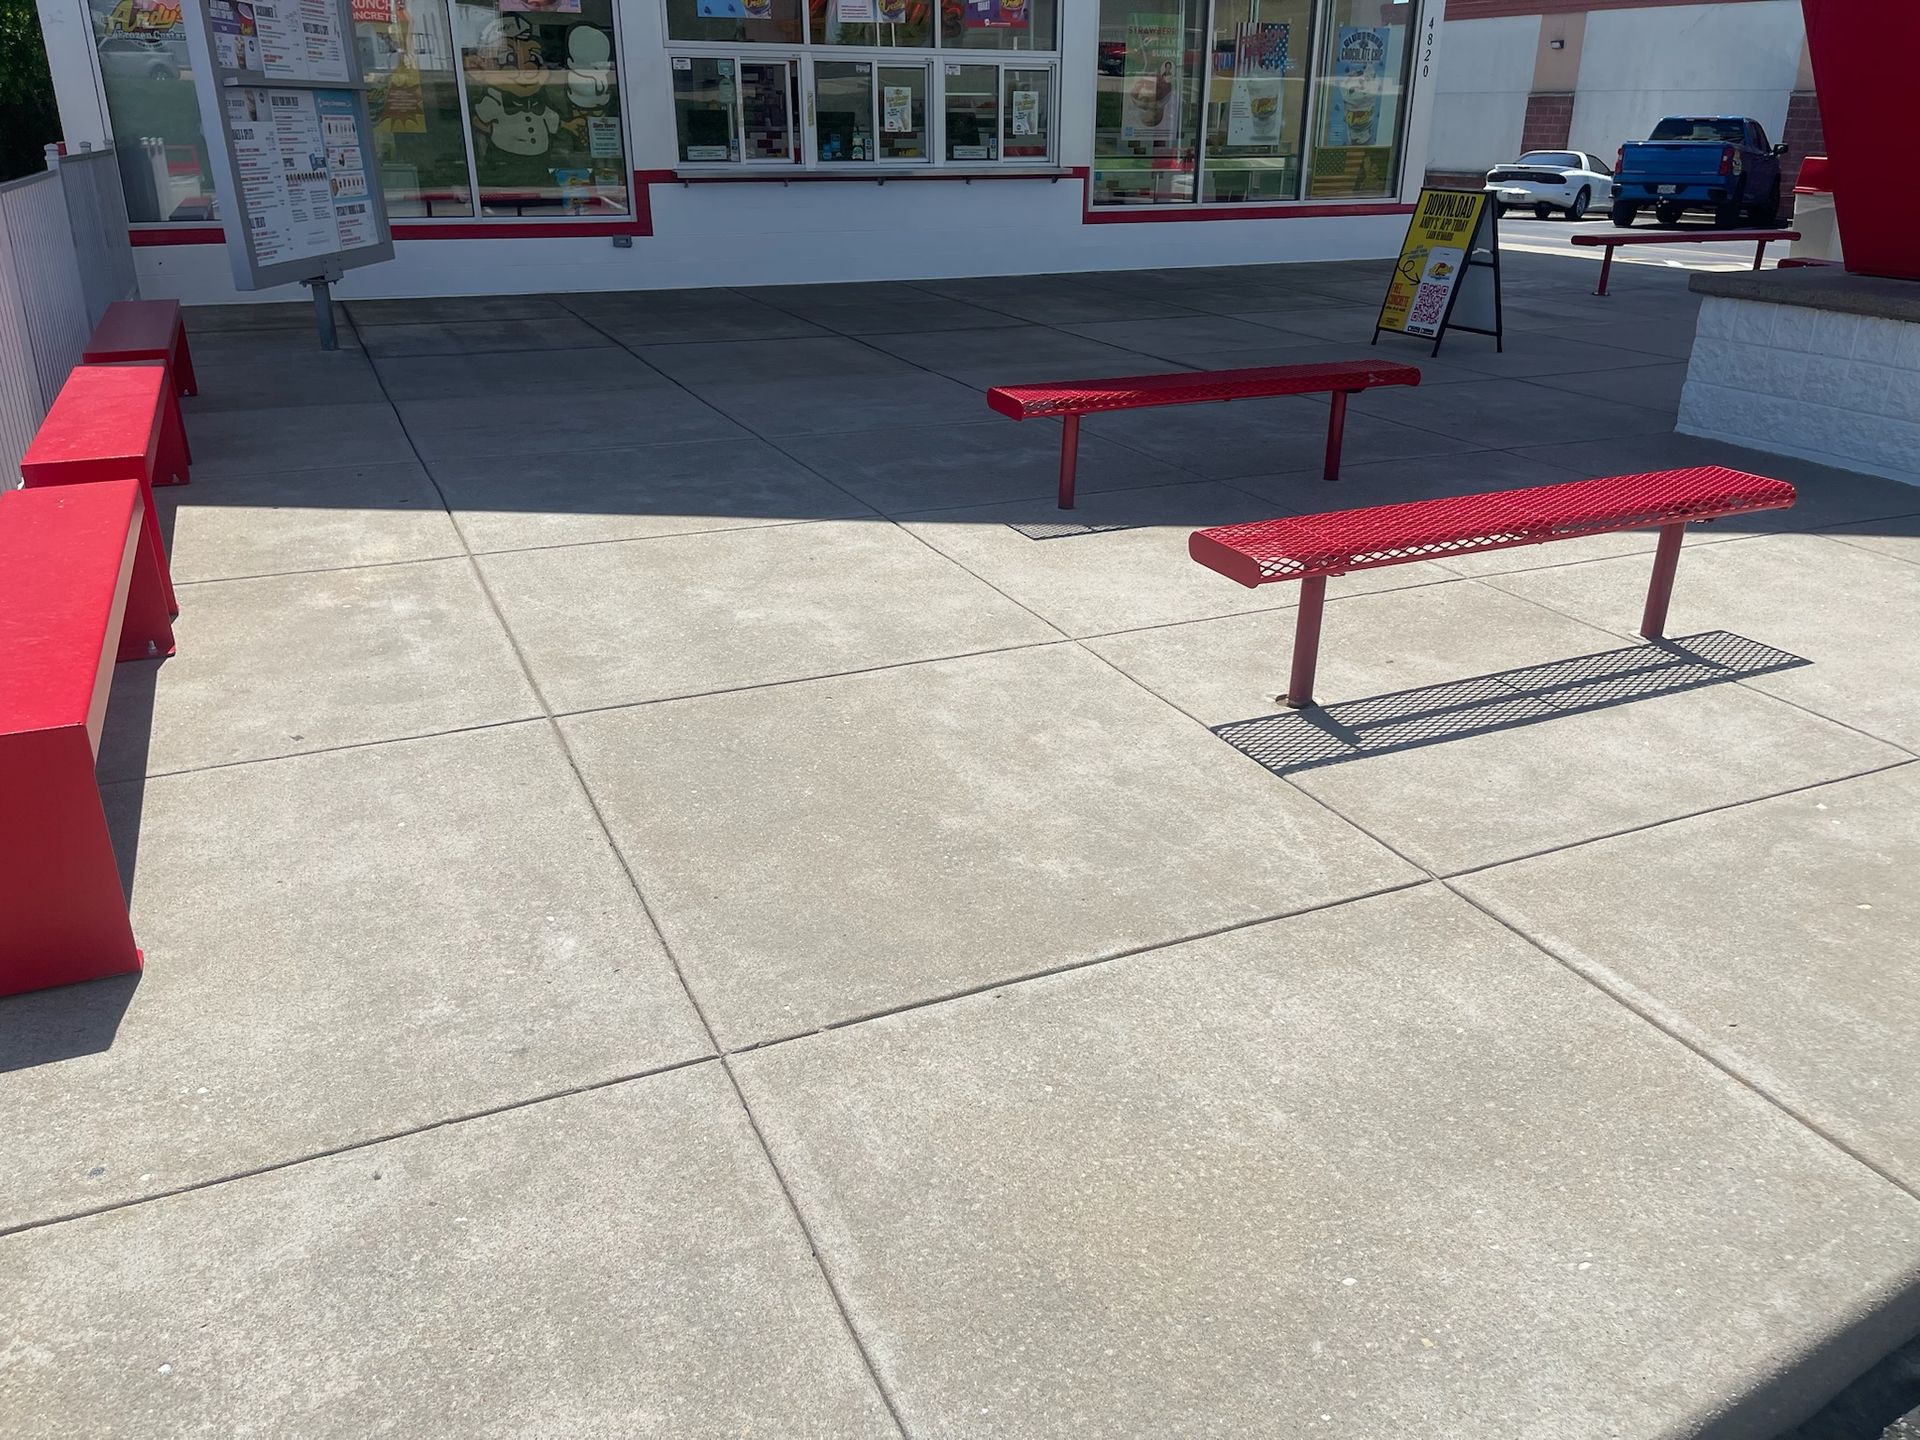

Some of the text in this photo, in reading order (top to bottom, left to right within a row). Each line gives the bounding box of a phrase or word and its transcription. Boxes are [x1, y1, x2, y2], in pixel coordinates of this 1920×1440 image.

[1422, 17, 1434, 77] 4820
[1423, 193, 1476, 218] DOWNLOAD
[1439, 218, 1453, 231] APP
[1452, 219, 1470, 232] TODAY
